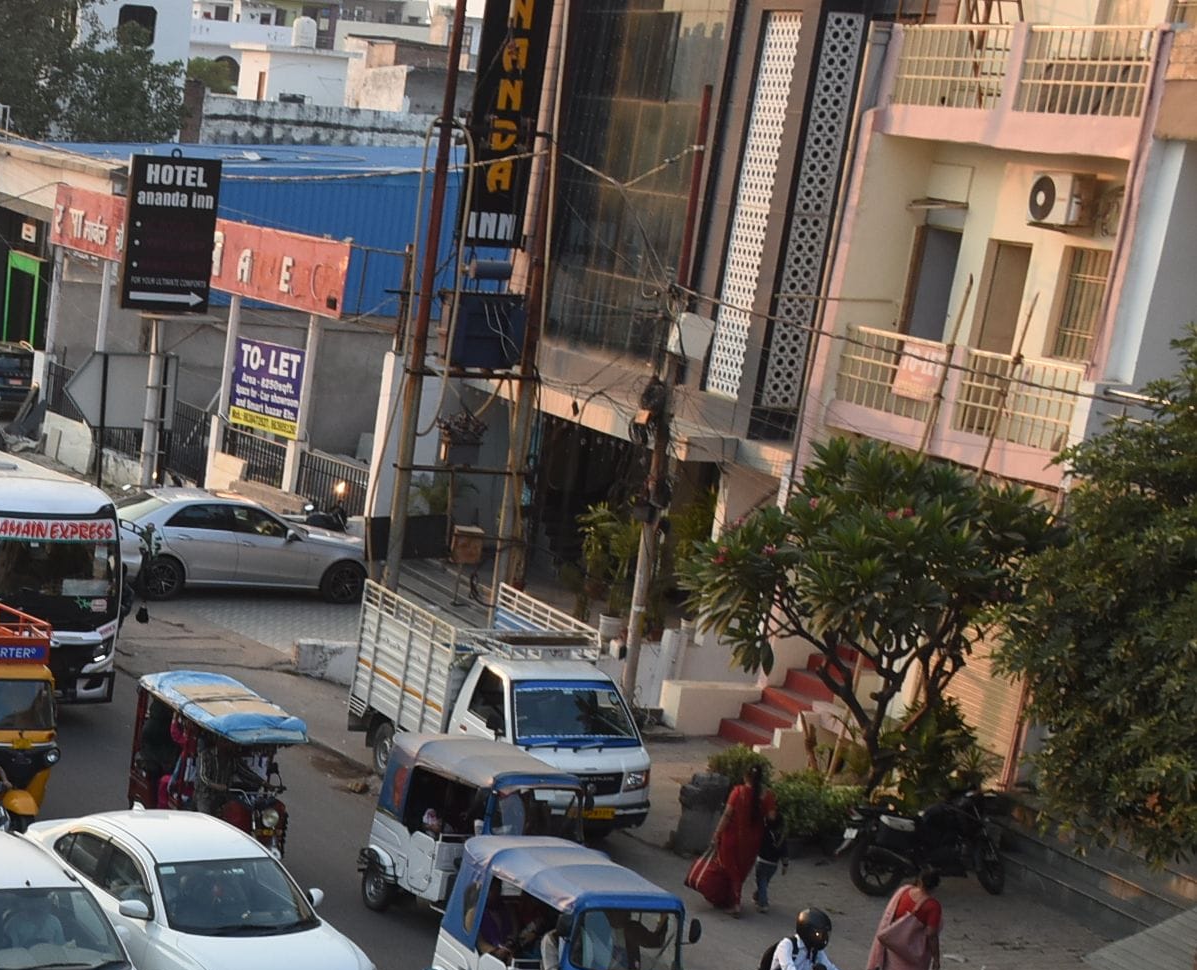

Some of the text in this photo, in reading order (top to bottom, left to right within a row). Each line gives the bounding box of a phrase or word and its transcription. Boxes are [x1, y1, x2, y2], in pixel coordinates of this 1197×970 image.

[146, 163, 208, 188] HOTEL
[137, 190, 214, 209] ananda inn
[268, 350, 301, 379] LET
[50, 521, 113, 541] EXPRESS
